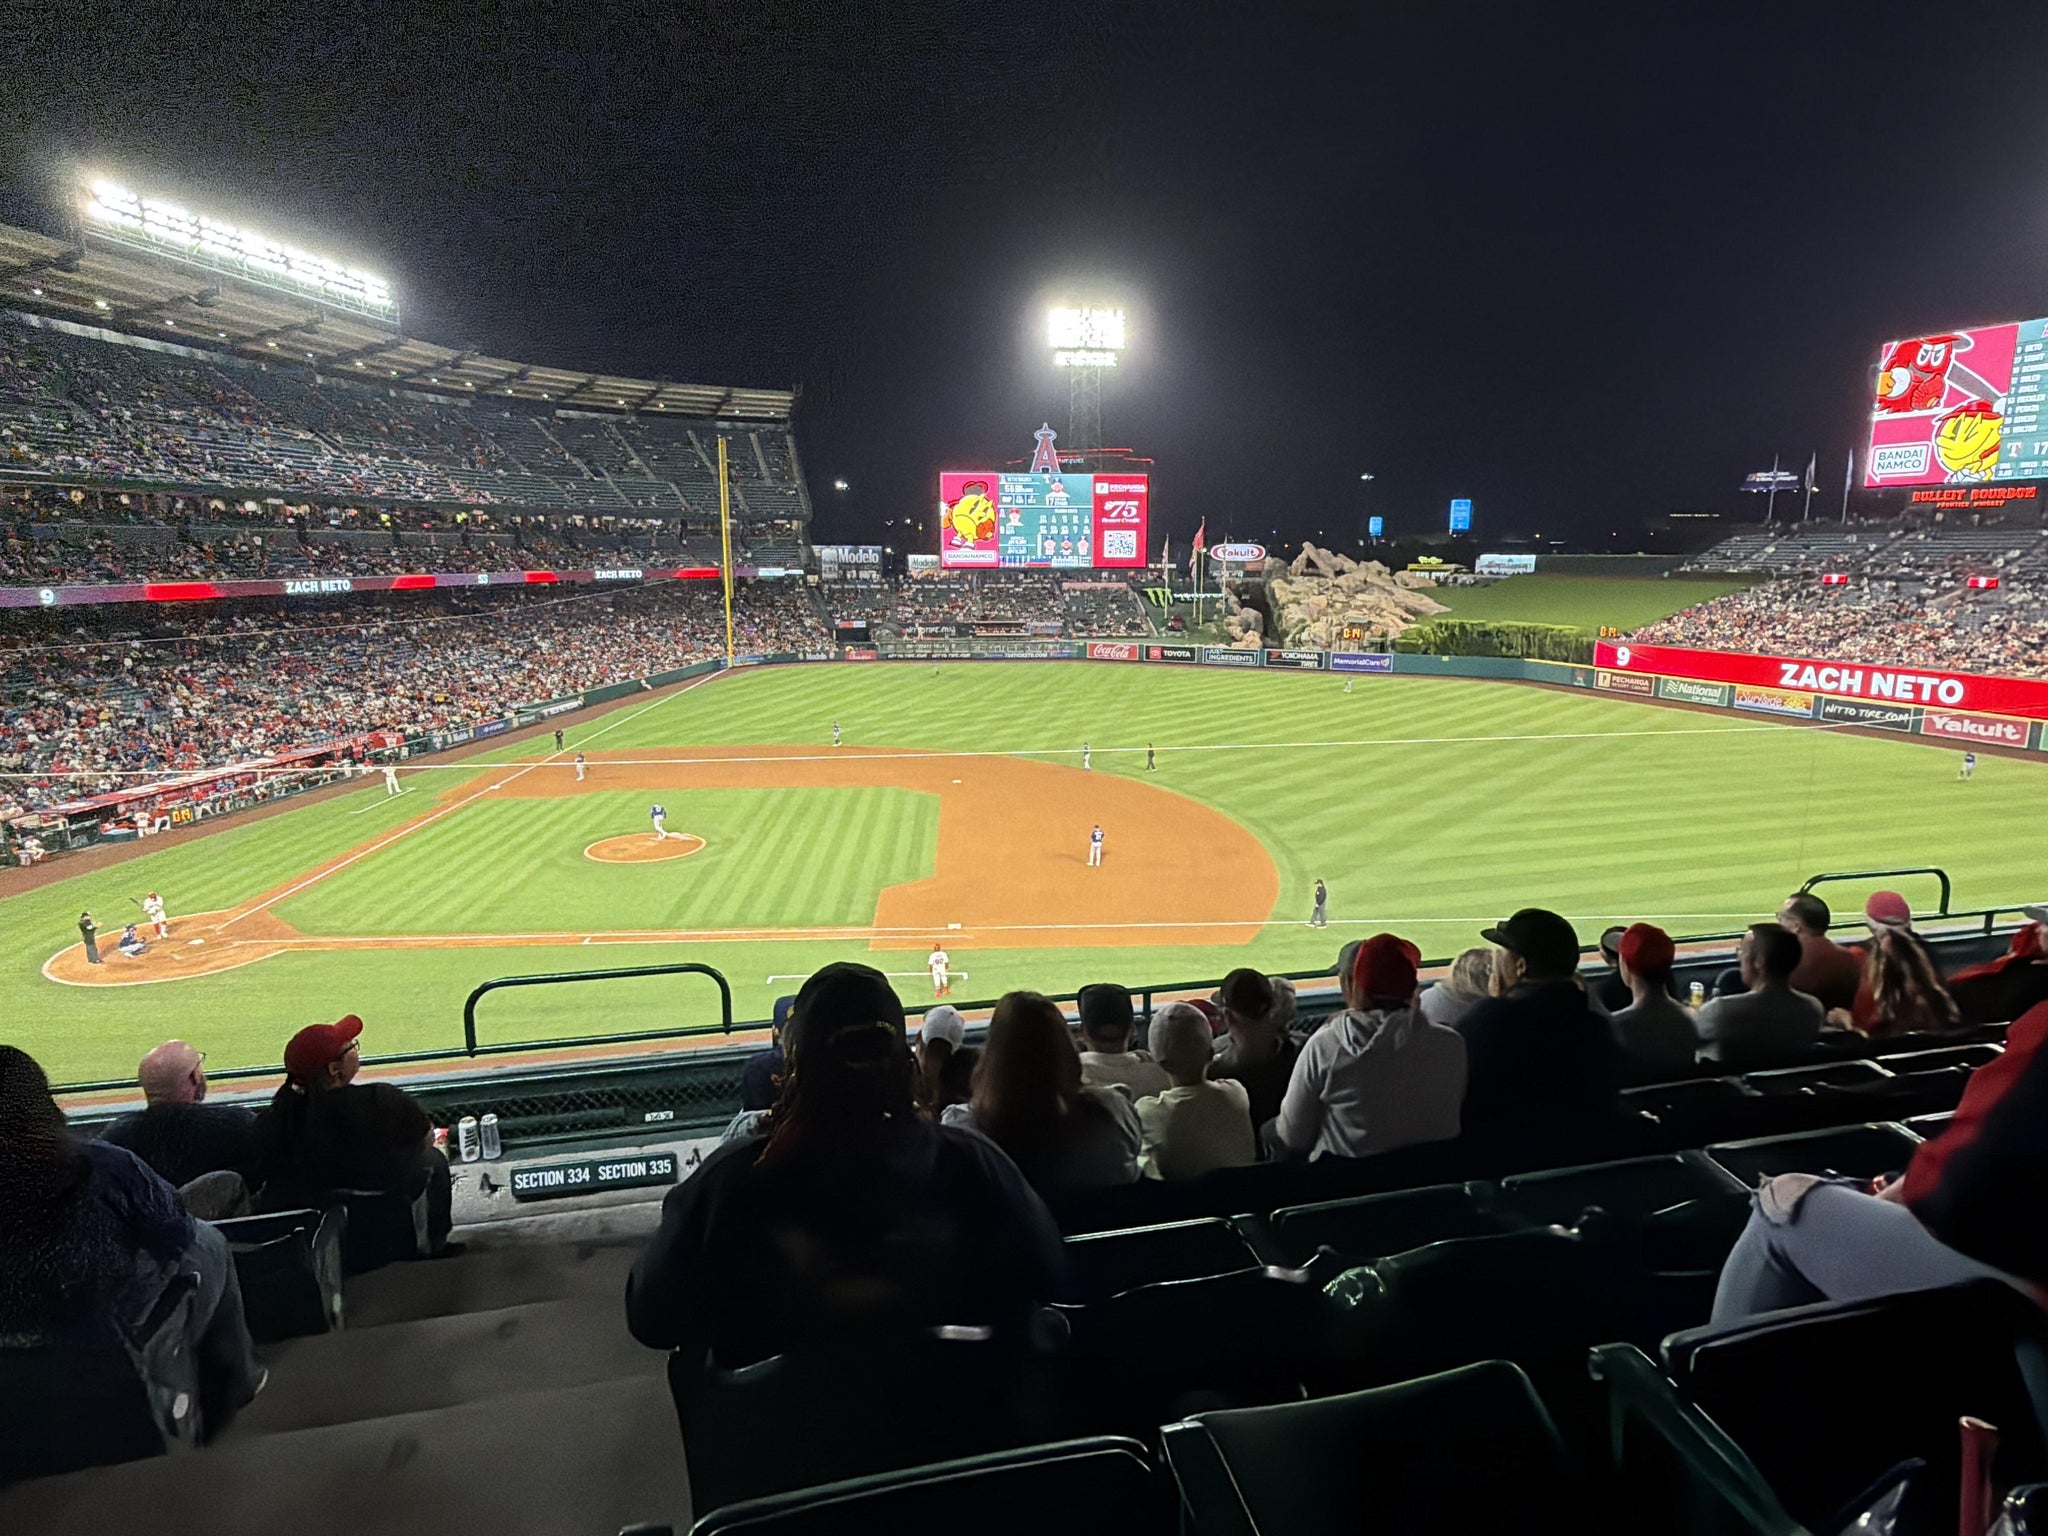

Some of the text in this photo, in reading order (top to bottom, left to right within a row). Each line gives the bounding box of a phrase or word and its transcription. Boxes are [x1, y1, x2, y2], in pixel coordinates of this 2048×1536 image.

[1878, 448, 1923, 460] BANDAI
[1877, 459, 1922, 471] NAMCO
[838, 549, 880, 563] Modelo
[1219, 548, 1257, 558] Yakult
[286, 580, 351, 593] ZACH NETO
[40, 588, 56, 606] 9
[1163, 650, 1191, 658] TOYOTA
[1616, 646, 1631, 666] 9
[1334, 657, 1380, 666] MemorialCare
[1611, 675, 1650, 687] PECHANGA
[1780, 663, 1964, 704] ZACH NETO
[1678, 684, 1722, 698] National
[1825, 704, 1909, 722] NITTO TIRE.COM
[1930, 714, 2022, 740] Yakult
[514, 1159, 672, 1189] SECTION 334 SECTION 335
